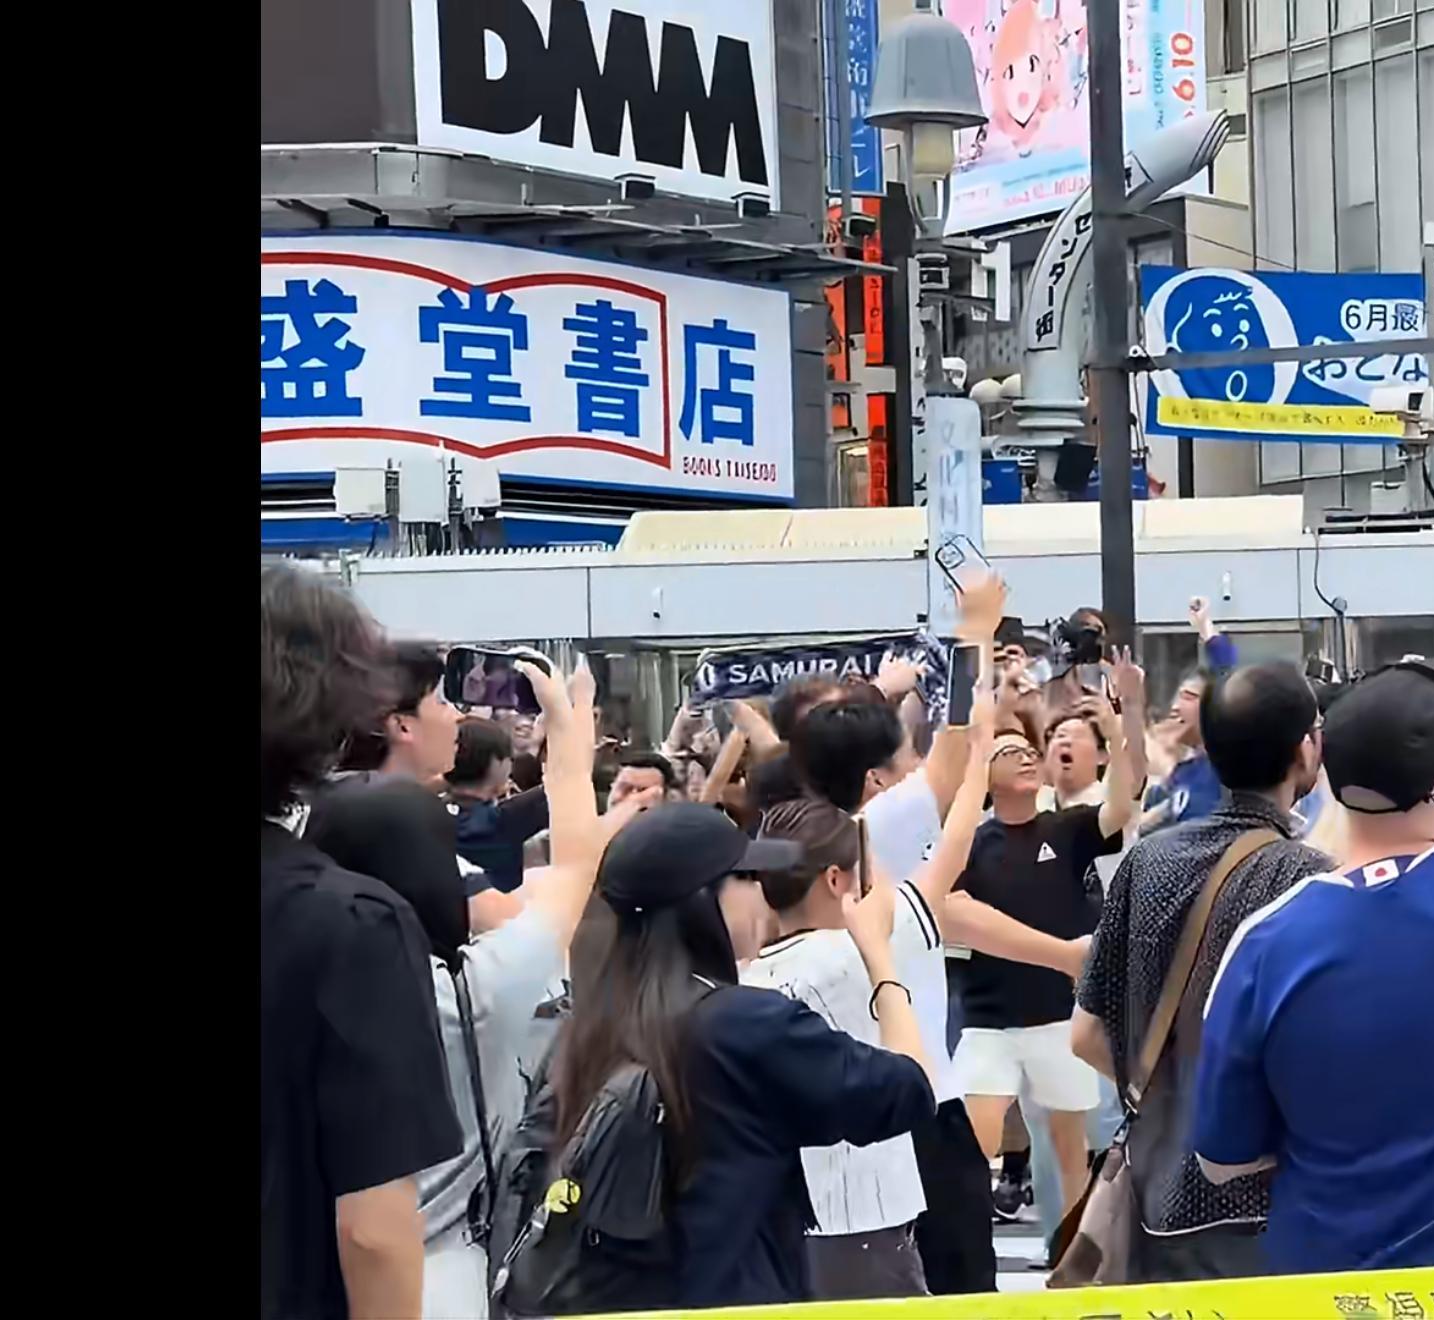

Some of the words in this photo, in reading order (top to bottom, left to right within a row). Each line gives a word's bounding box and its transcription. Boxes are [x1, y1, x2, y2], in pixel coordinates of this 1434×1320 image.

[437, 0, 770, 187] DMM
[260, 278, 757, 447] 盛堂書店
